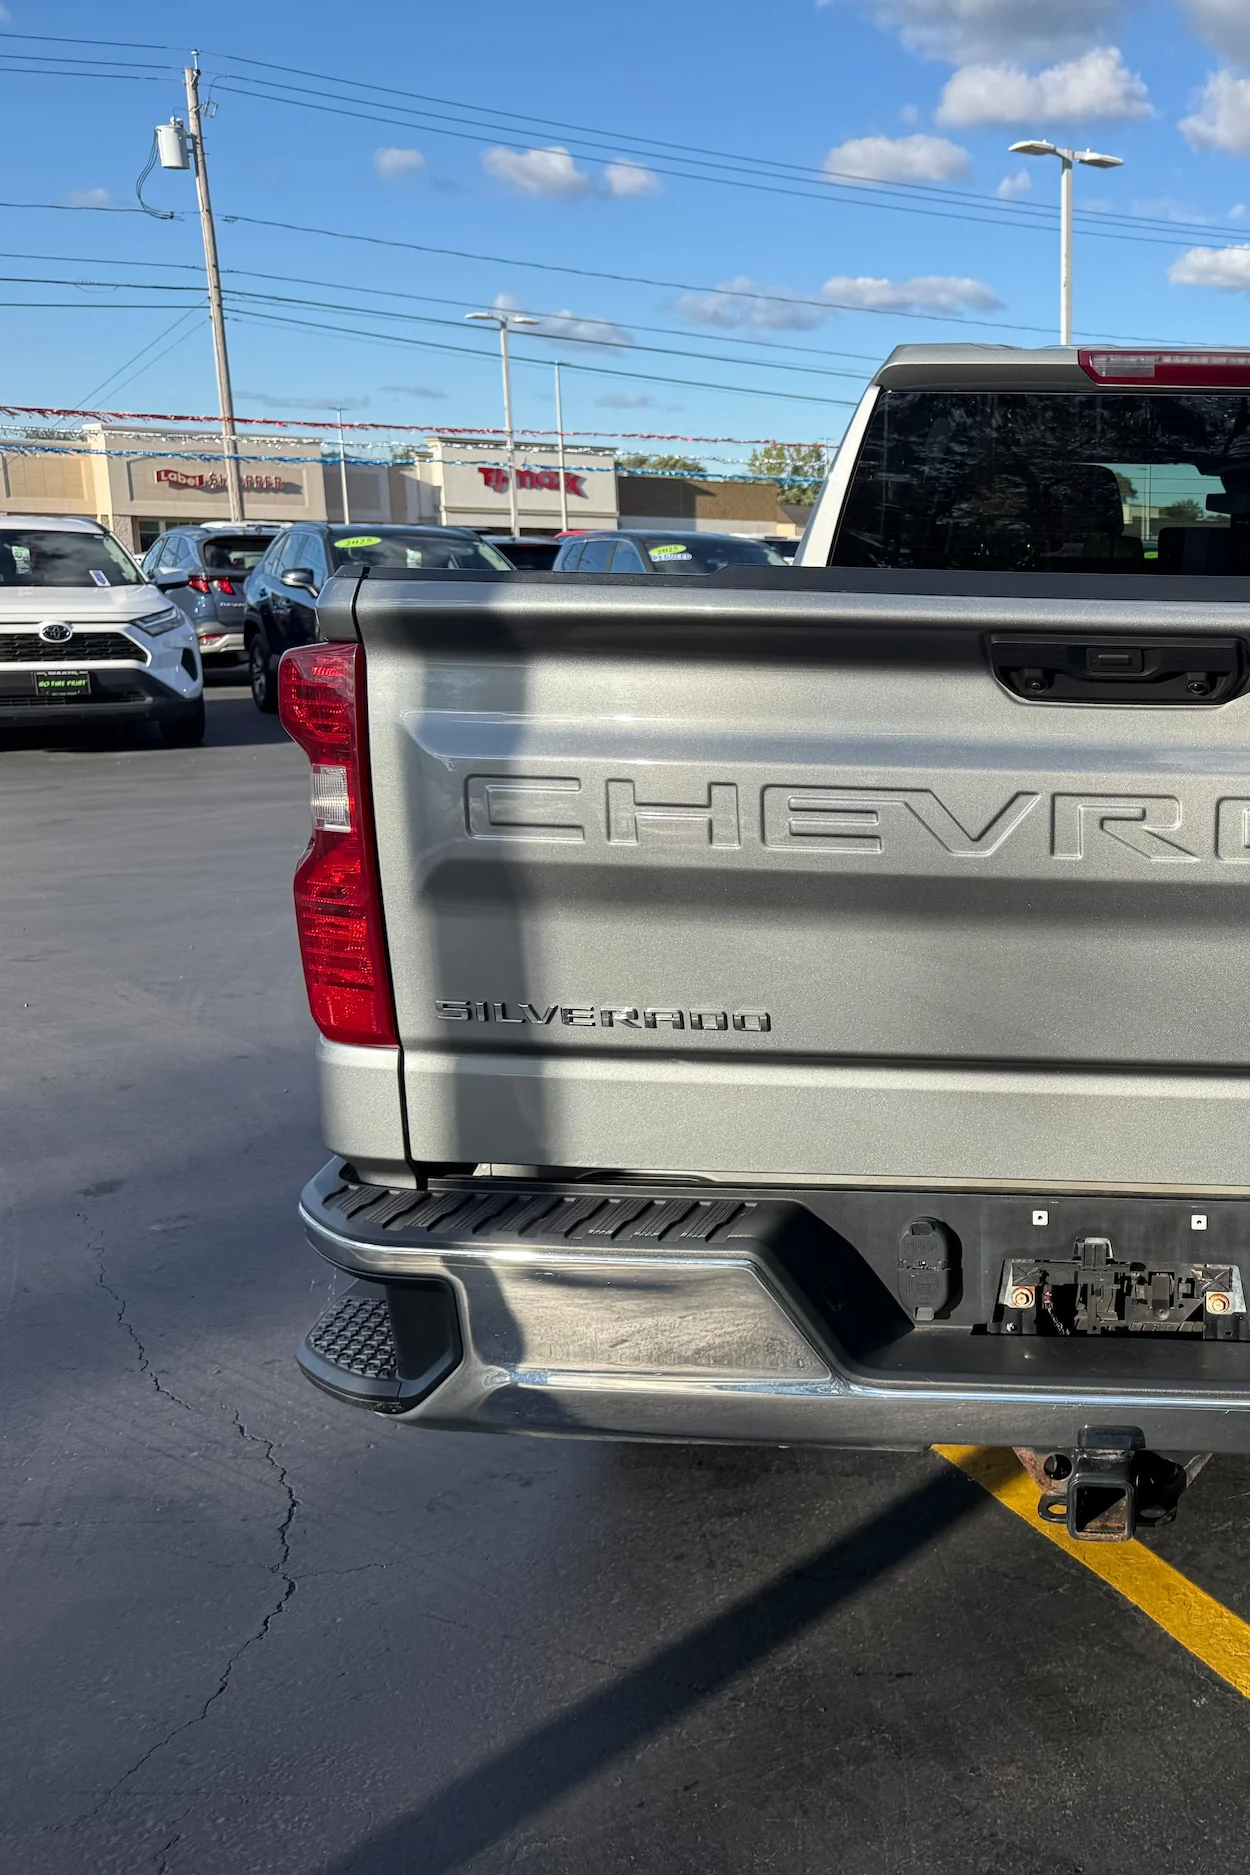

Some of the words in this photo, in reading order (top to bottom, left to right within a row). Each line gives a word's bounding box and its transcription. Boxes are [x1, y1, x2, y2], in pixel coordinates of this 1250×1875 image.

[160, 469, 200, 487] Label
[208, 470, 283, 489] SHPPER
[434, 1000, 772, 1033] SILVERADO
